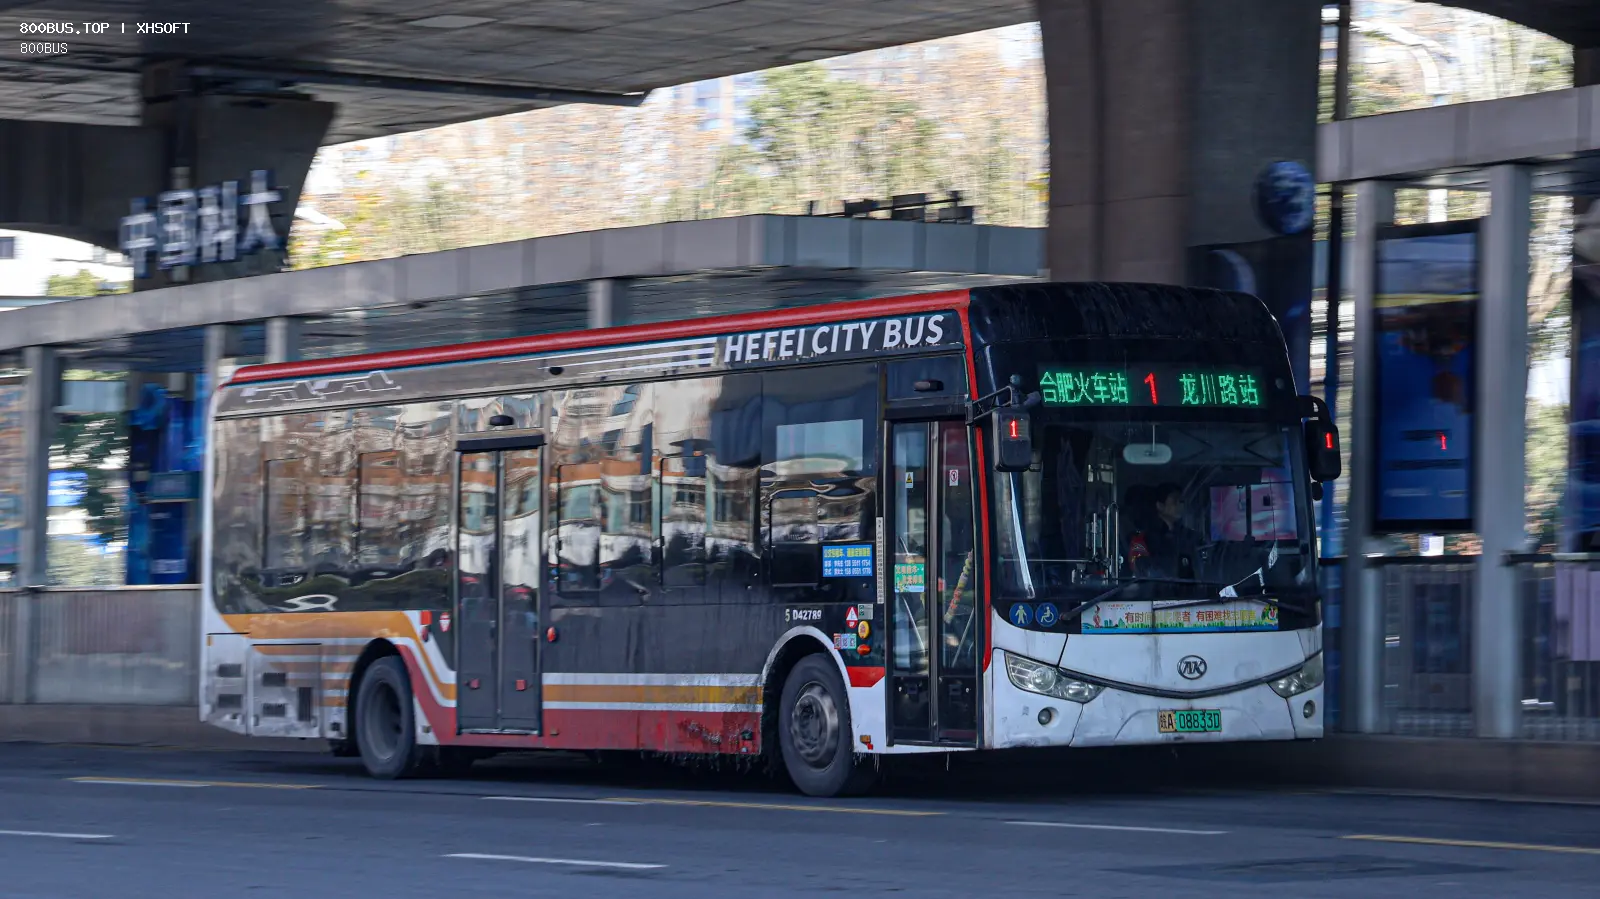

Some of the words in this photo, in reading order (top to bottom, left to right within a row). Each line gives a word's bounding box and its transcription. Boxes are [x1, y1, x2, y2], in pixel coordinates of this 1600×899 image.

[724, 329, 806, 363] HEFEI
[811, 321, 877, 355] CITY
[882, 314, 944, 348] BUS
[1039, 371, 1129, 404] 合肥火车站
[1144, 372, 1157, 405] 1
[1179, 373, 1259, 406] 龙川路站
[1009, 419, 1018, 438] 1
[1325, 431, 1334, 448] 1
[785, 608, 791, 622] 5
[792, 609, 822, 620] D42789
